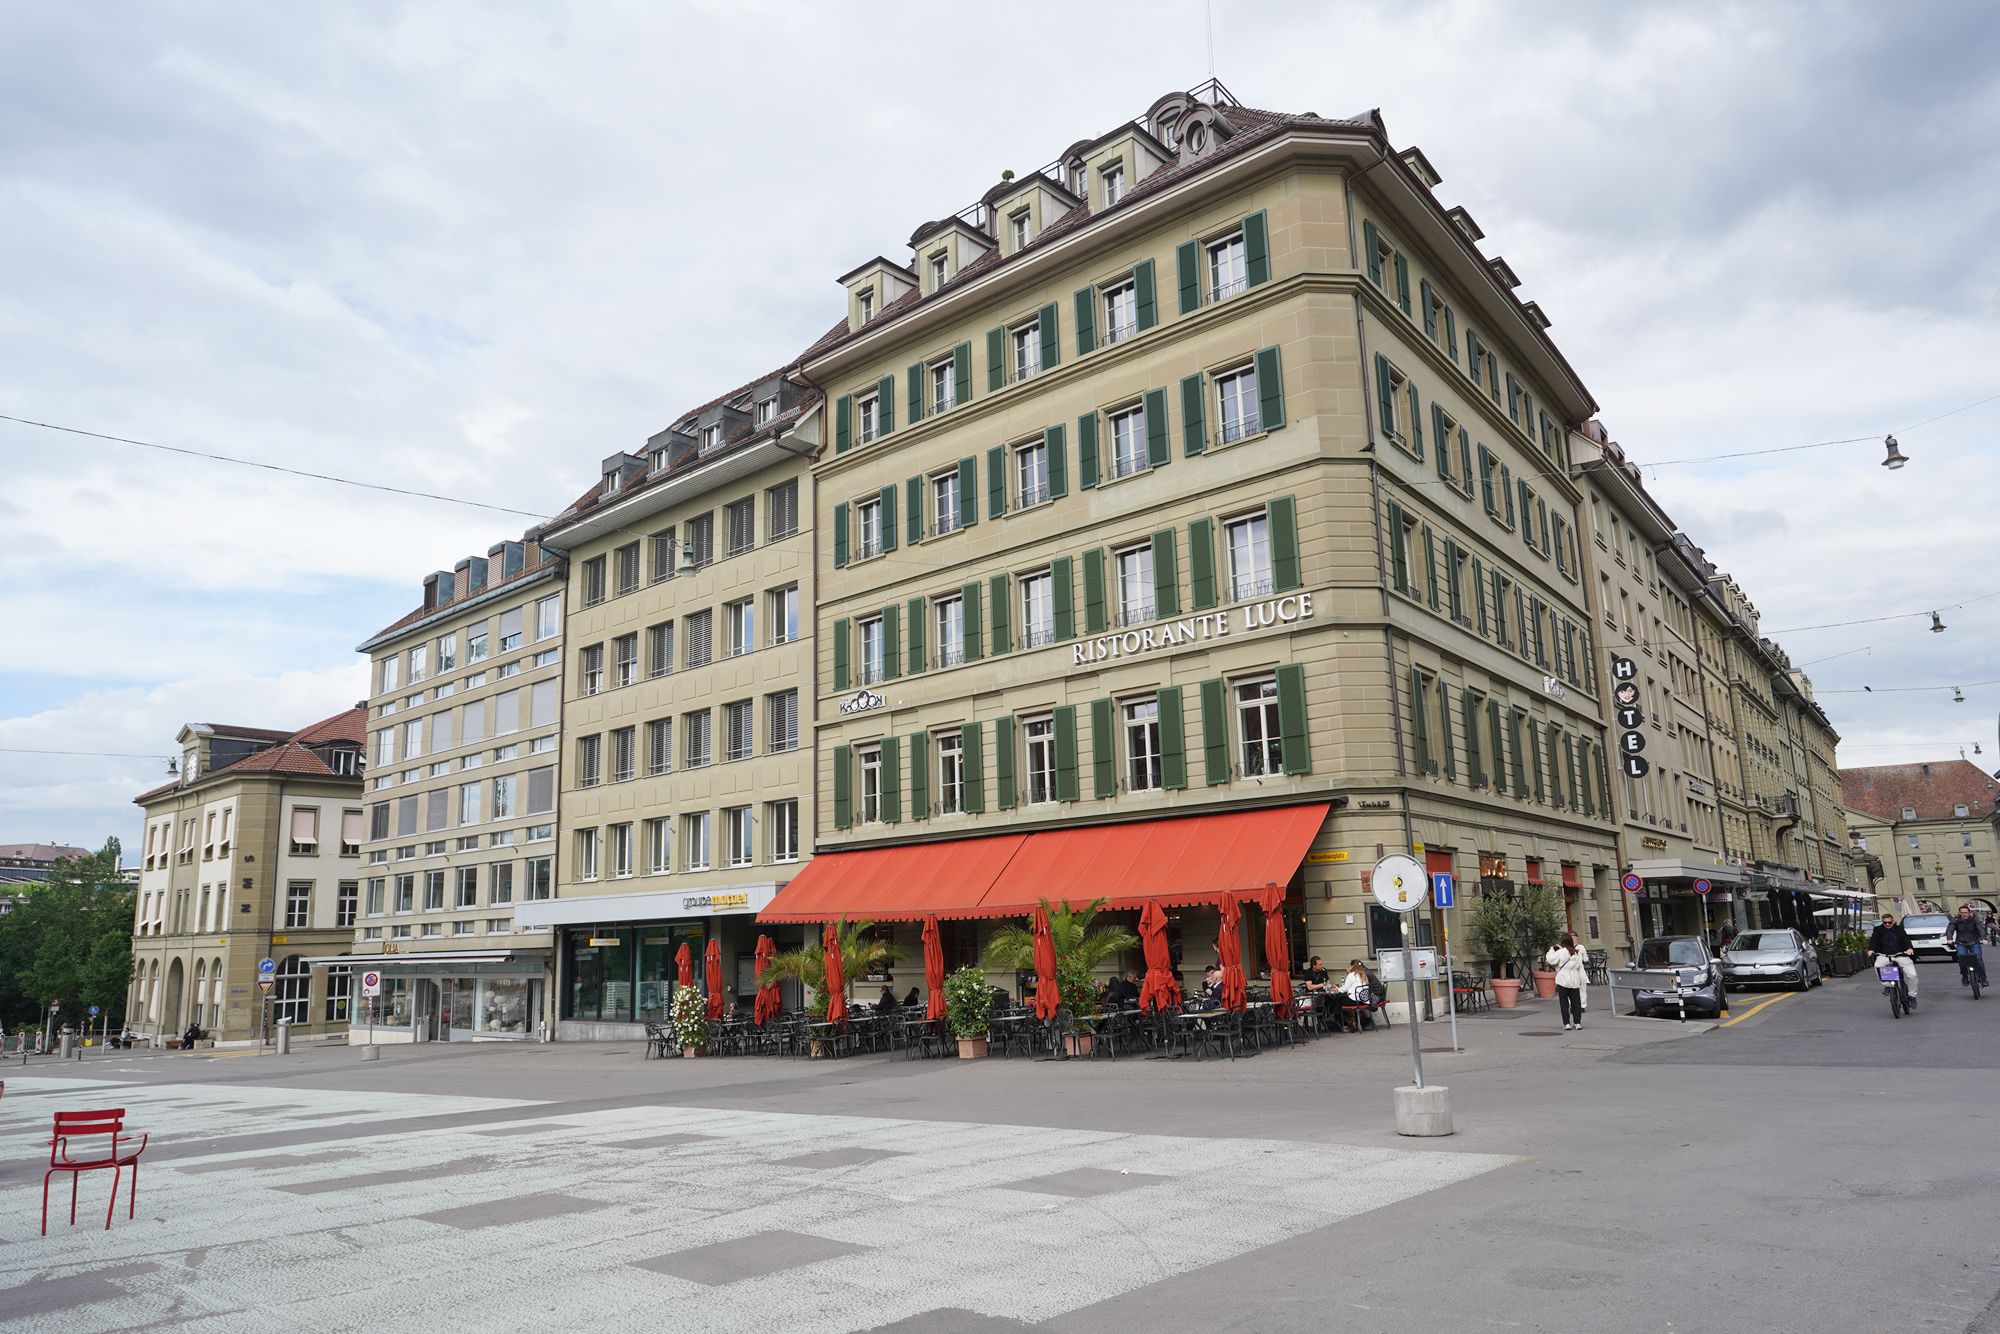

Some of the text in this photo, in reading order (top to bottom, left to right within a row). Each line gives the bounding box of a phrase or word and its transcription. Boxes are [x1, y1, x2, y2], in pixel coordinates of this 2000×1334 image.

[1072, 593, 1314, 665] RISTORANTE LUCE
[1613, 660, 1645, 776] HOTEL
